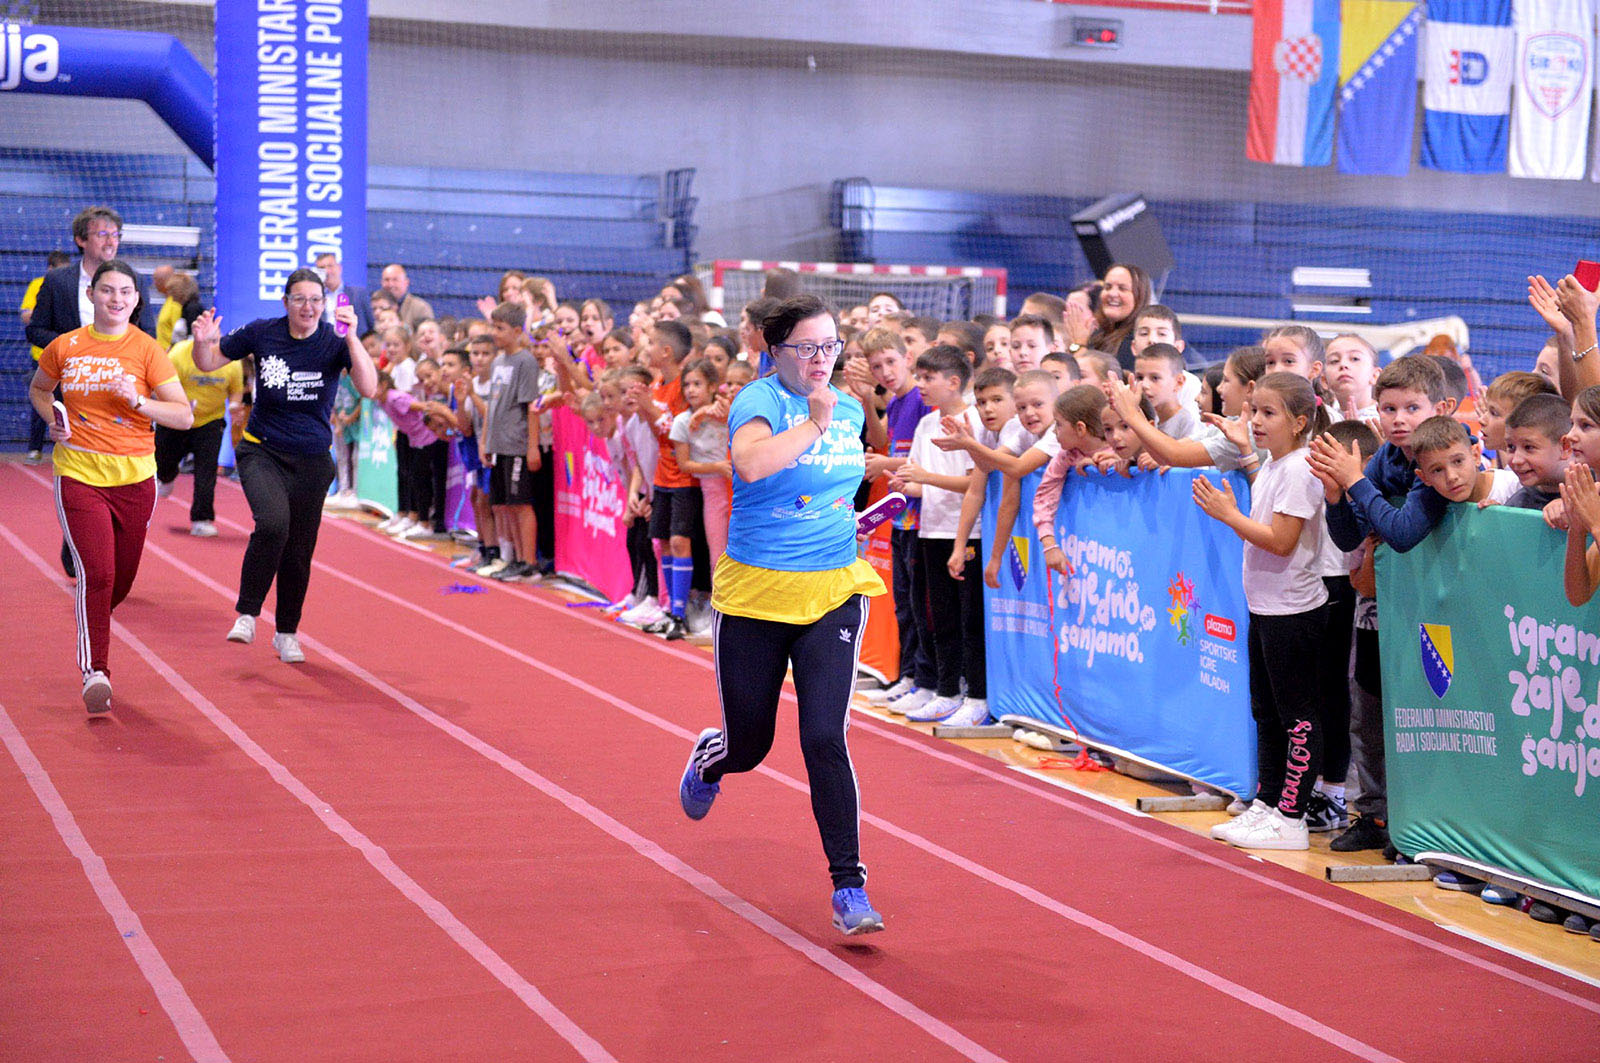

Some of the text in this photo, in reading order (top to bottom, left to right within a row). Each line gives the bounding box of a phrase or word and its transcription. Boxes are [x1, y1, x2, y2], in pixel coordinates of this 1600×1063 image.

[305, 50, 343, 203] SOCIJALNE
[258, 142, 299, 300] FEDERALNO
[306, 209, 342, 219] I
[1206, 618, 1233, 636] plazma
[1200, 640, 1238, 664] SPORTSKE
[1200, 654, 1217, 673] IGRE
[1200, 670, 1230, 694] MLADIH
[1395, 708, 1496, 732] FEDERALNO MINISTARSTVO
[1395, 732, 1498, 757] RADA I SOCIJALNE POLITIKE
